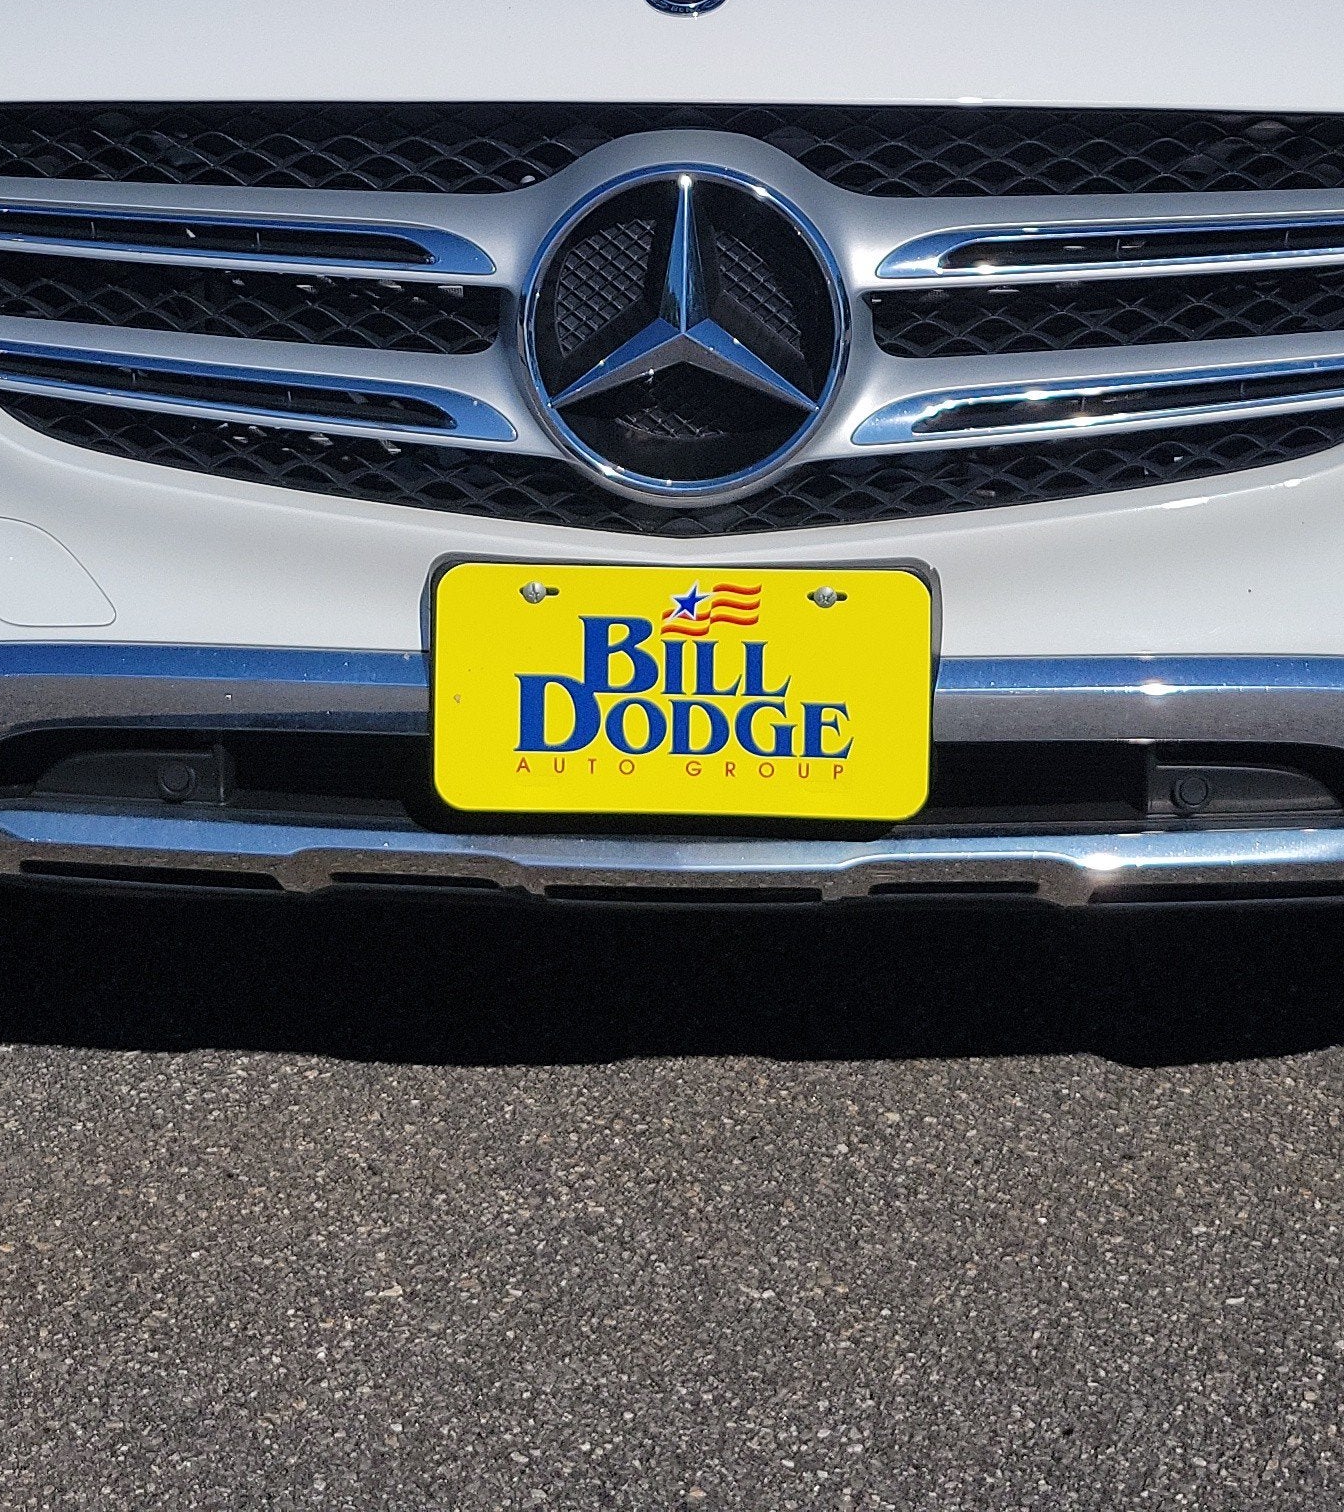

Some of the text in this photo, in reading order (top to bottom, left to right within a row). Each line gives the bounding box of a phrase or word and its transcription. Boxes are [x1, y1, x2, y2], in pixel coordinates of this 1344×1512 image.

[579, 615, 792, 696] BILL
[513, 672, 854, 759] DODGE
[516, 757, 845, 779] AUTO GROUP
